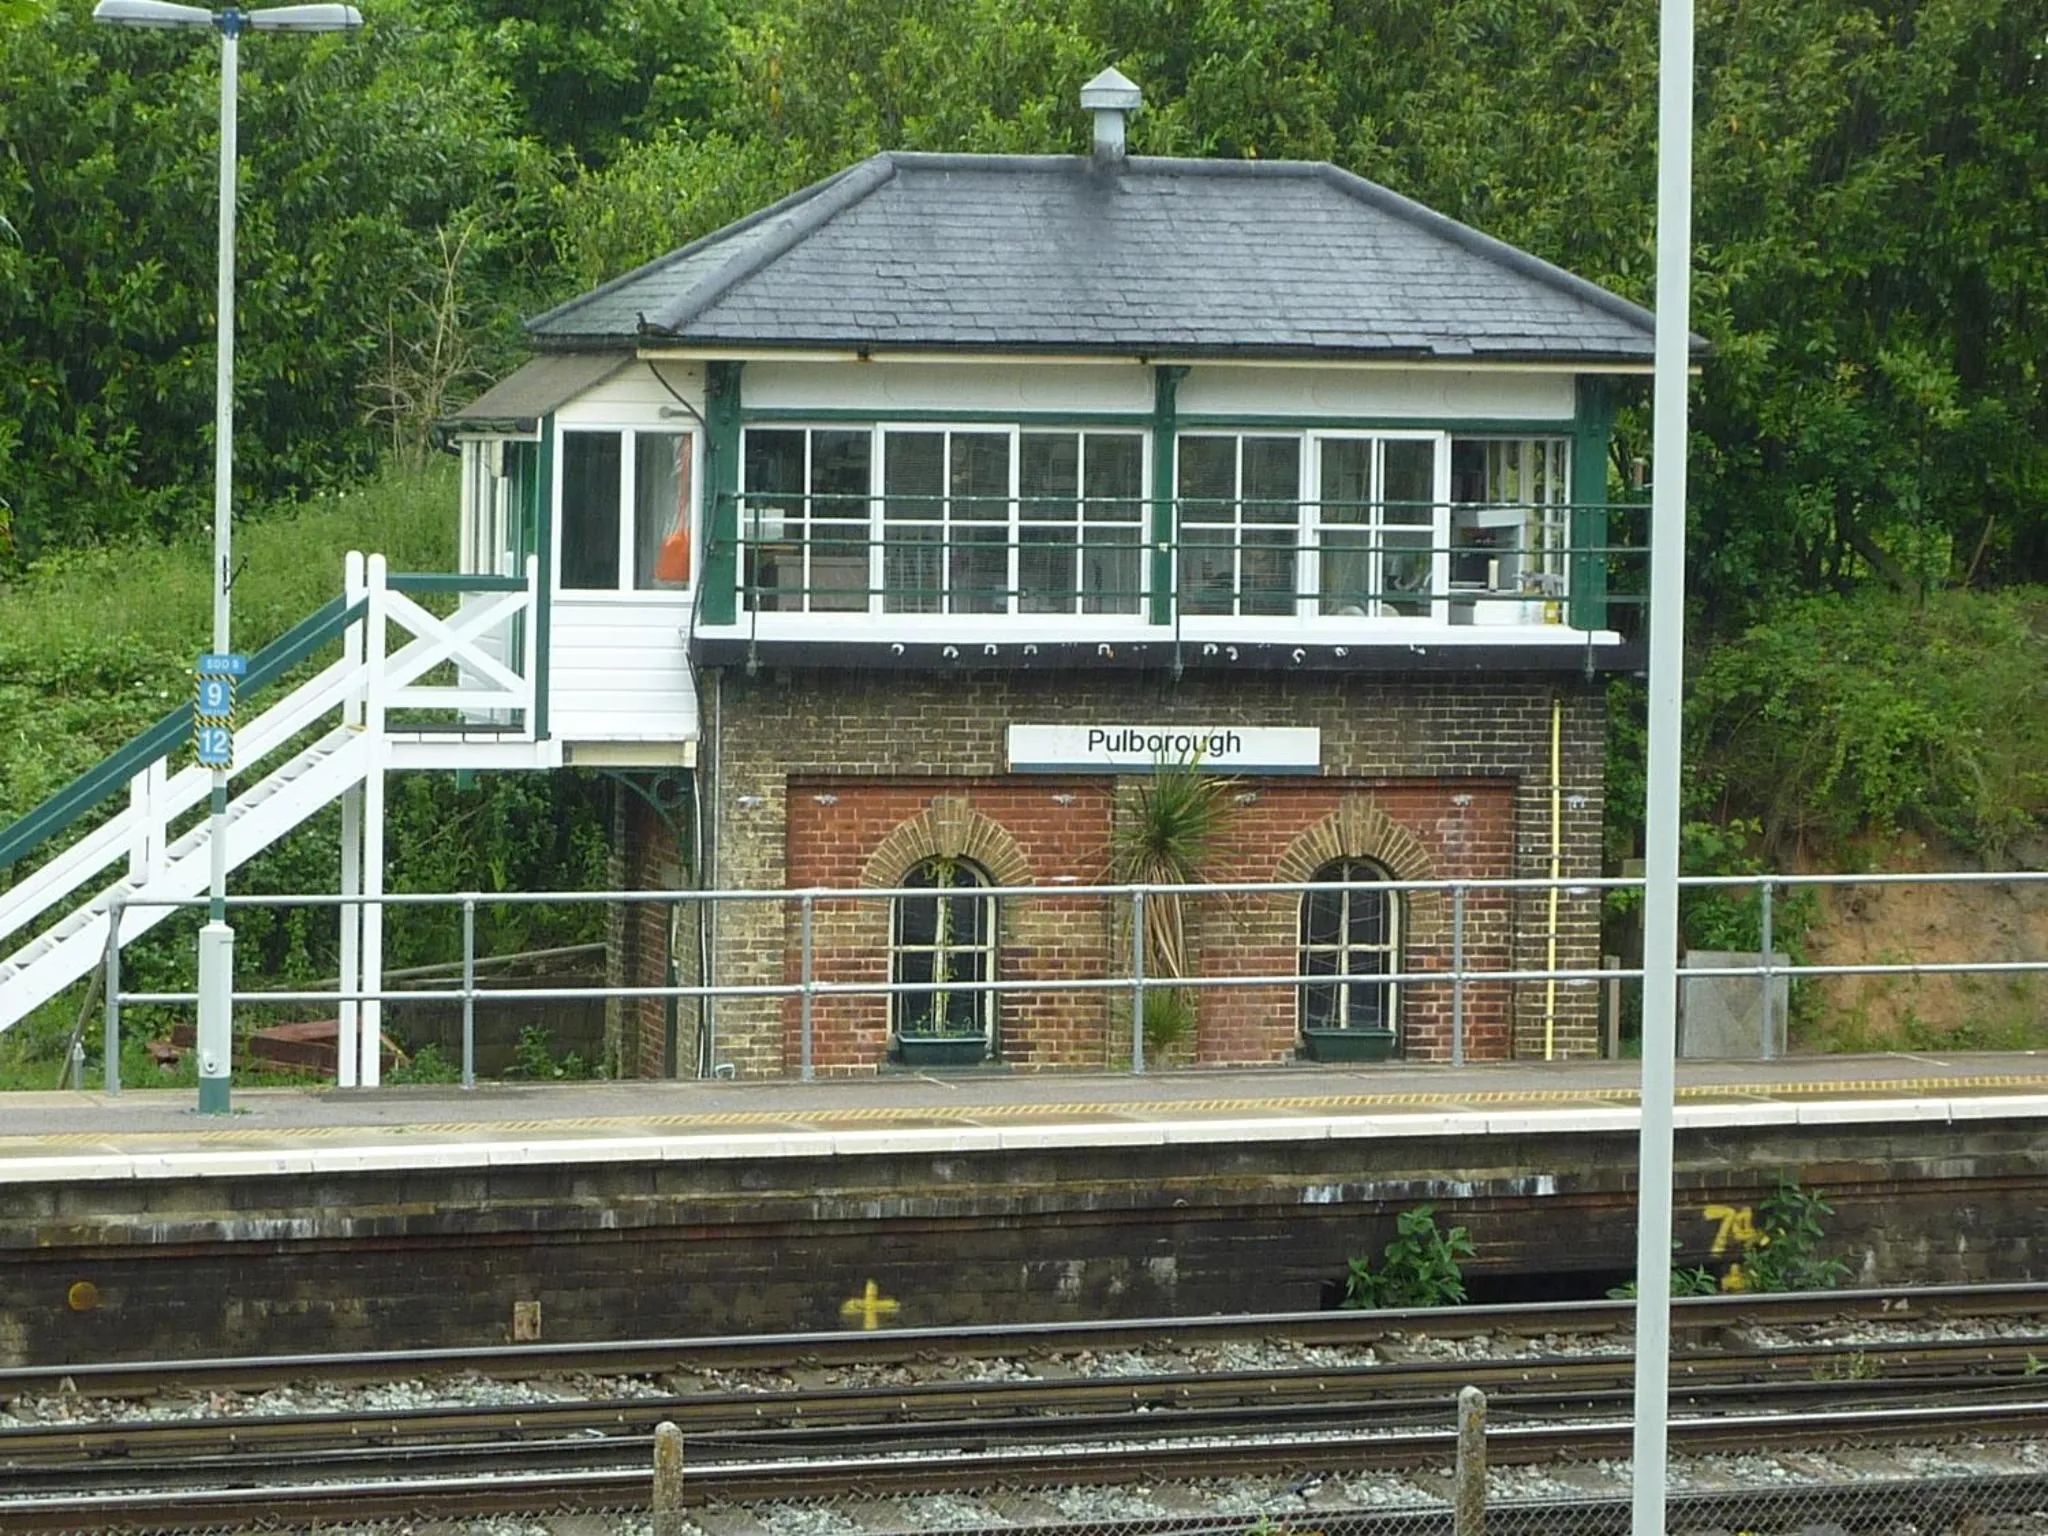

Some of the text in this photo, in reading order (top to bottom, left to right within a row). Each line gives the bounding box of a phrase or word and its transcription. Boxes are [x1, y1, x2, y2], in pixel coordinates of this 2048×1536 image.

[207, 683, 222, 706] 9
[201, 729, 228, 753] 12
[1088, 729, 1241, 757] Pulborough
